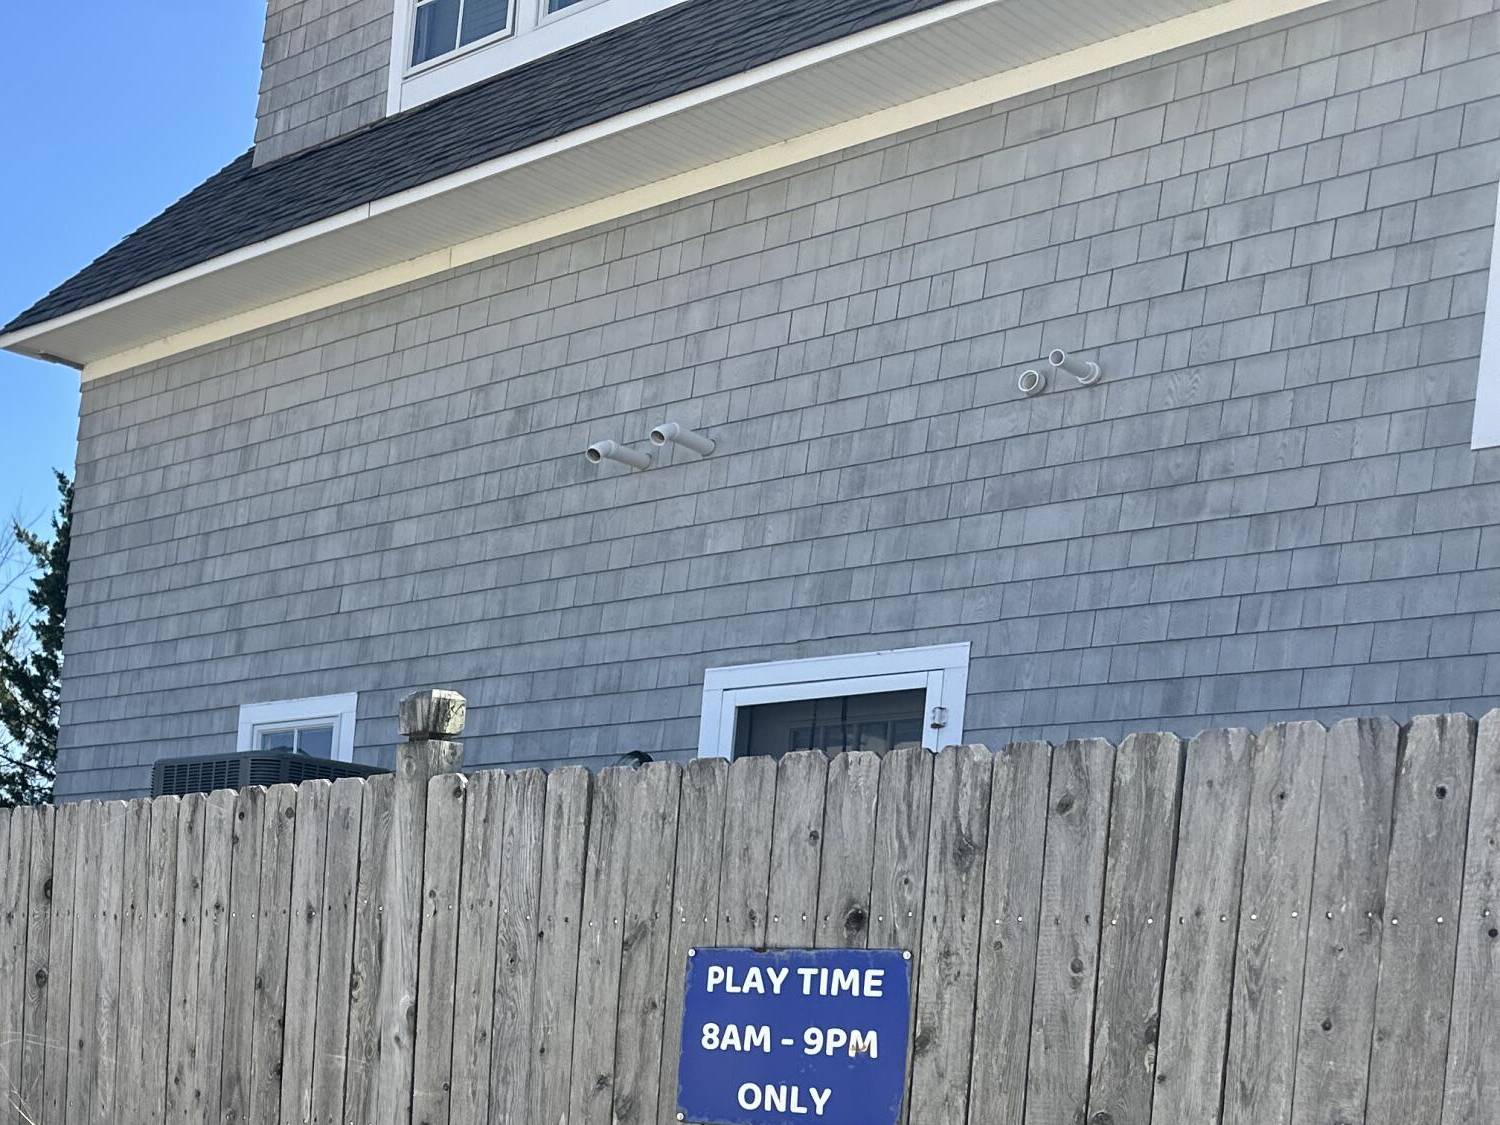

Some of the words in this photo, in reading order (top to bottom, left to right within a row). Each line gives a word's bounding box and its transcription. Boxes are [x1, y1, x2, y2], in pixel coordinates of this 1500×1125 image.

[706, 965, 789, 995] PLAY
[797, 967, 885, 998] TIME
[701, 1022, 771, 1053] 8AM
[781, 1038, 794, 1046] -
[803, 1027, 878, 1059] 9PM
[737, 1082, 832, 1115] ONLY
